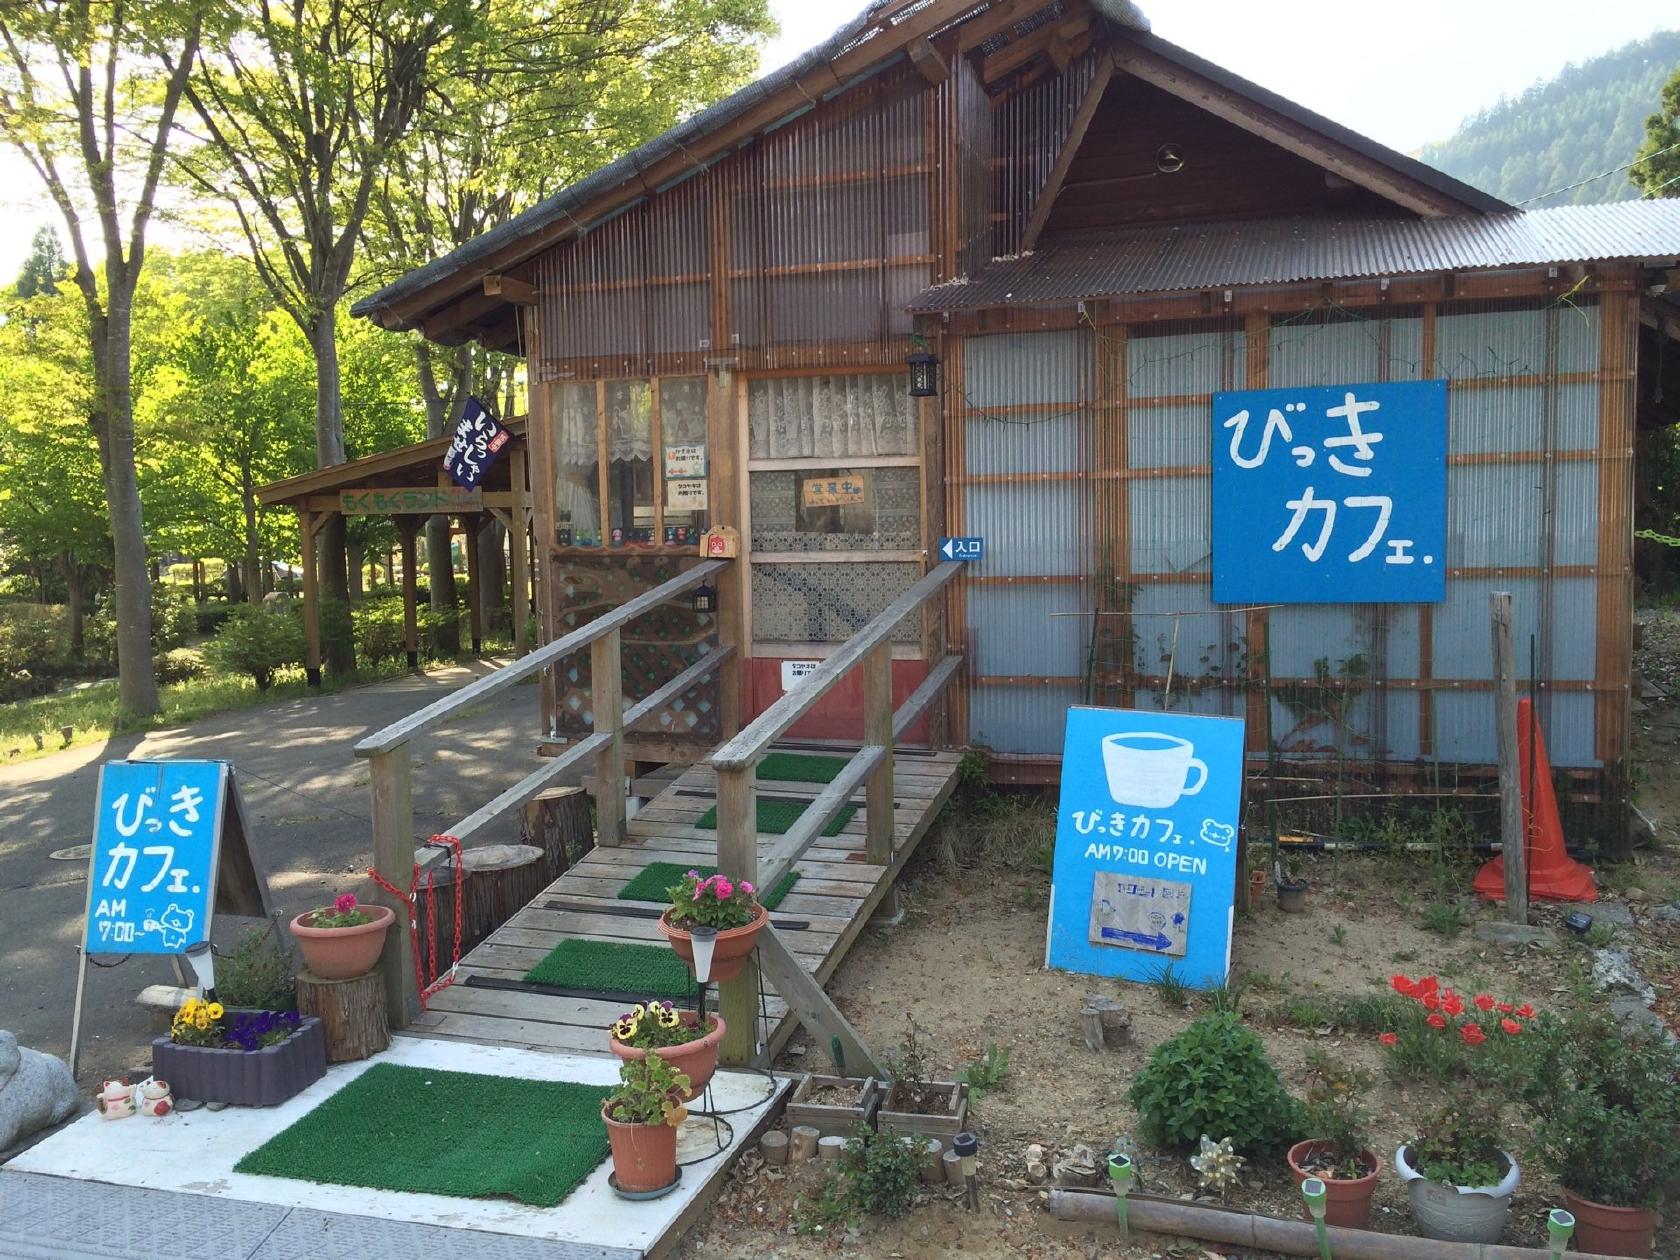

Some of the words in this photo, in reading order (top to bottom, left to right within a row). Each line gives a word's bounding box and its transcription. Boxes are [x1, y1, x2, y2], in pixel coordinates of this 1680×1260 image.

[1223, 392, 1384, 477] びっき
[955, 541, 980, 553] 入口
[111, 784, 203, 837] びっき
[1153, 851, 1207, 875] OPEN
[95, 898, 127, 917] AM
